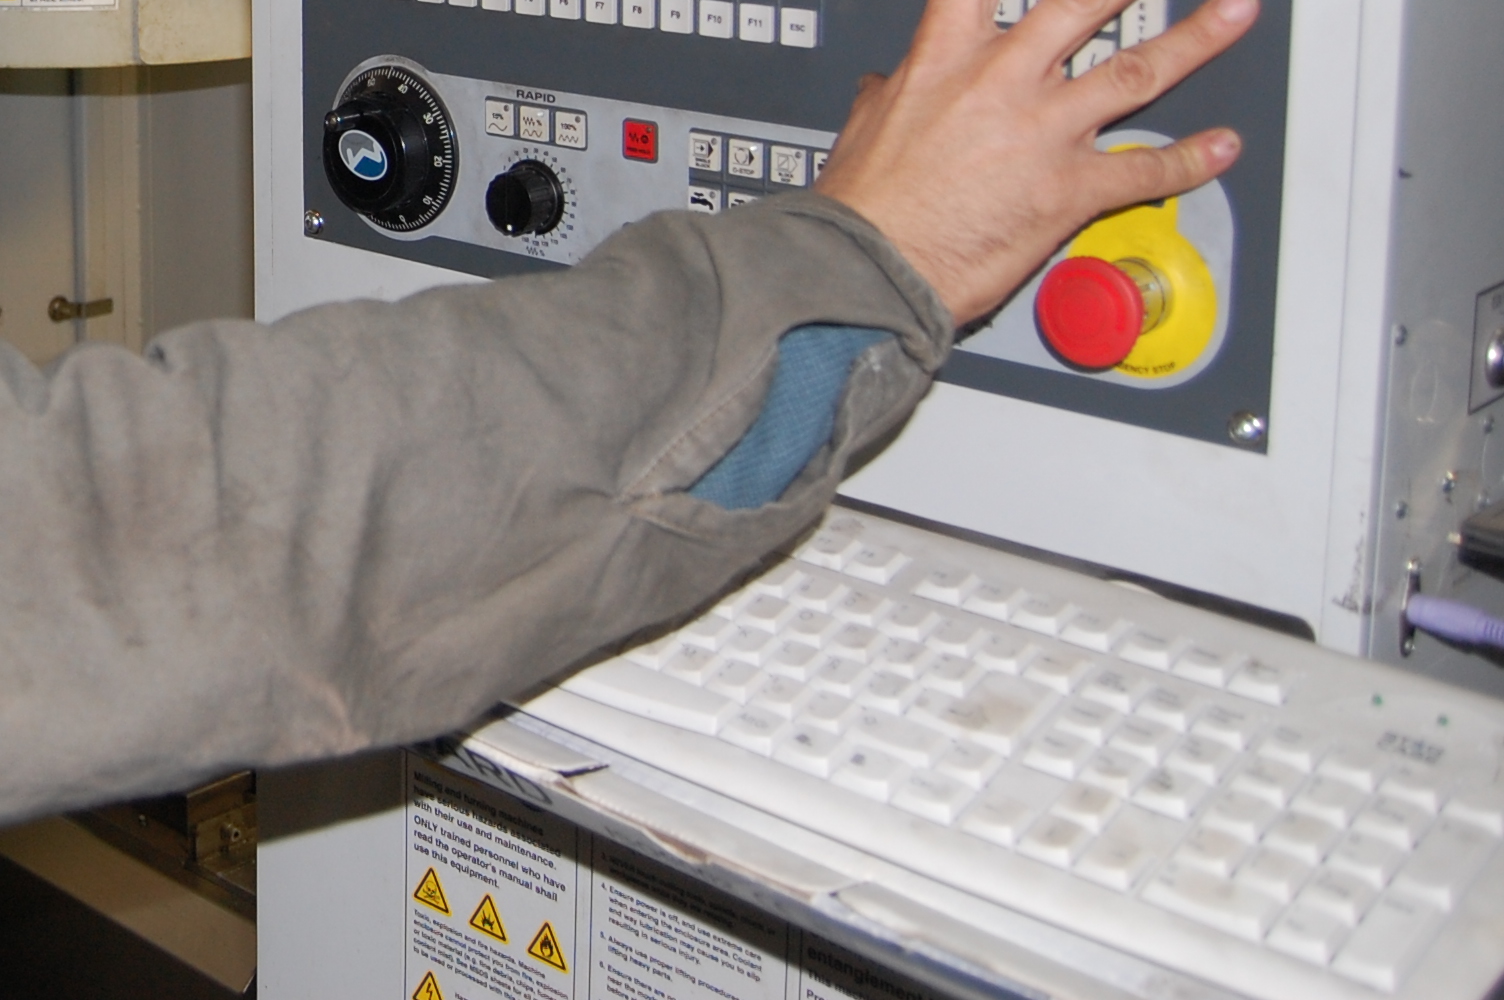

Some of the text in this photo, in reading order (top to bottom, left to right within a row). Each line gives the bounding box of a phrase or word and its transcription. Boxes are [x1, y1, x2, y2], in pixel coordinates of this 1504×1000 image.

[595, 2, 604, 10] F7
[633, 5, 642, 14] F8
[671, 11, 680, 19] F9
[707, 14, 722, 24] F10
[748, 18, 762, 27] F11
[790, 23, 805, 32] ESC
[517, 90, 555, 103] RAPID
[434, 156, 442, 167] 20
[423, 195, 433, 205] 10
[414, 796, 556, 871] with their use and maintenance.
[437, 794, 470, 818] serious
[473, 810, 507, 834] hazards
[511, 827, 561, 859] associated
[414, 813, 565, 893] ONLY trained personnel who have
[414, 827, 557, 902] read the operator's manual shall
[414, 840, 499, 891] use this equipment.
